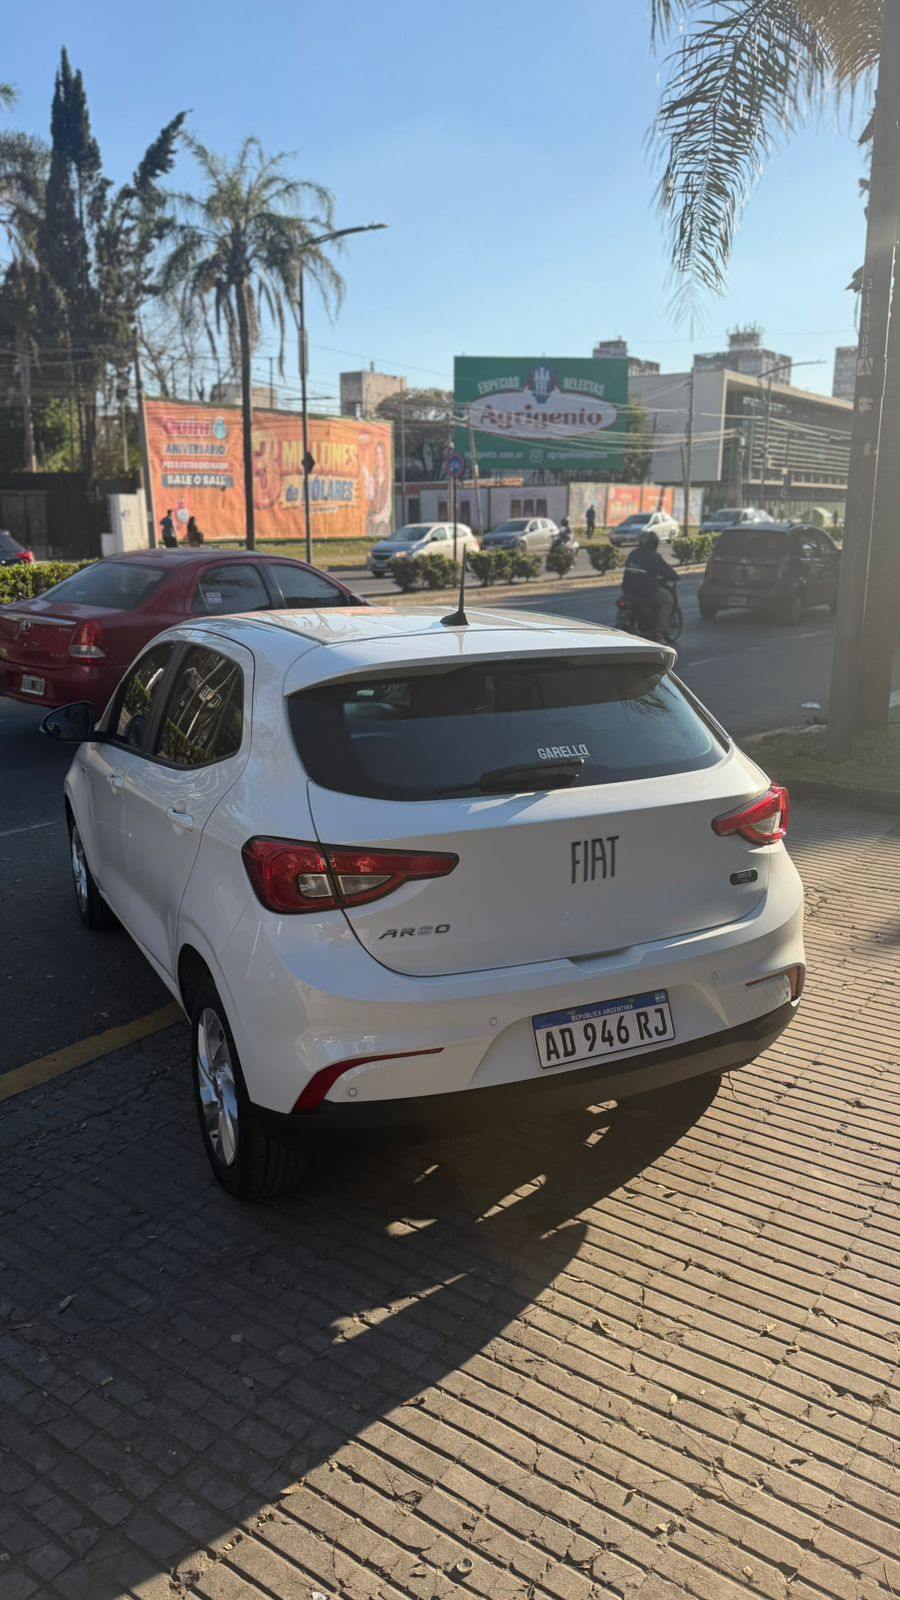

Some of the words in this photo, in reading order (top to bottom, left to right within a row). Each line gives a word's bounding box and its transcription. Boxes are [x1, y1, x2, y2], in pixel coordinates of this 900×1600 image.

[477, 376, 520, 394] ESPECIAS
[563, 377, 605, 396] SELECTAS
[480, 404, 603, 428] Agrigento
[165, 443, 227, 455] ANIVERSARIO
[282, 440, 358, 471] MILONES
[167, 475, 192, 485] SALE
[571, 836, 619, 884] FIAT
[378, 924, 450, 940] ARGO
[602, 1003, 634, 1015] ARGENTINA
[545, 1027, 577, 1061] AD
[583, 1015, 630, 1052] 946
[636, 1007, 668, 1040] RJ
